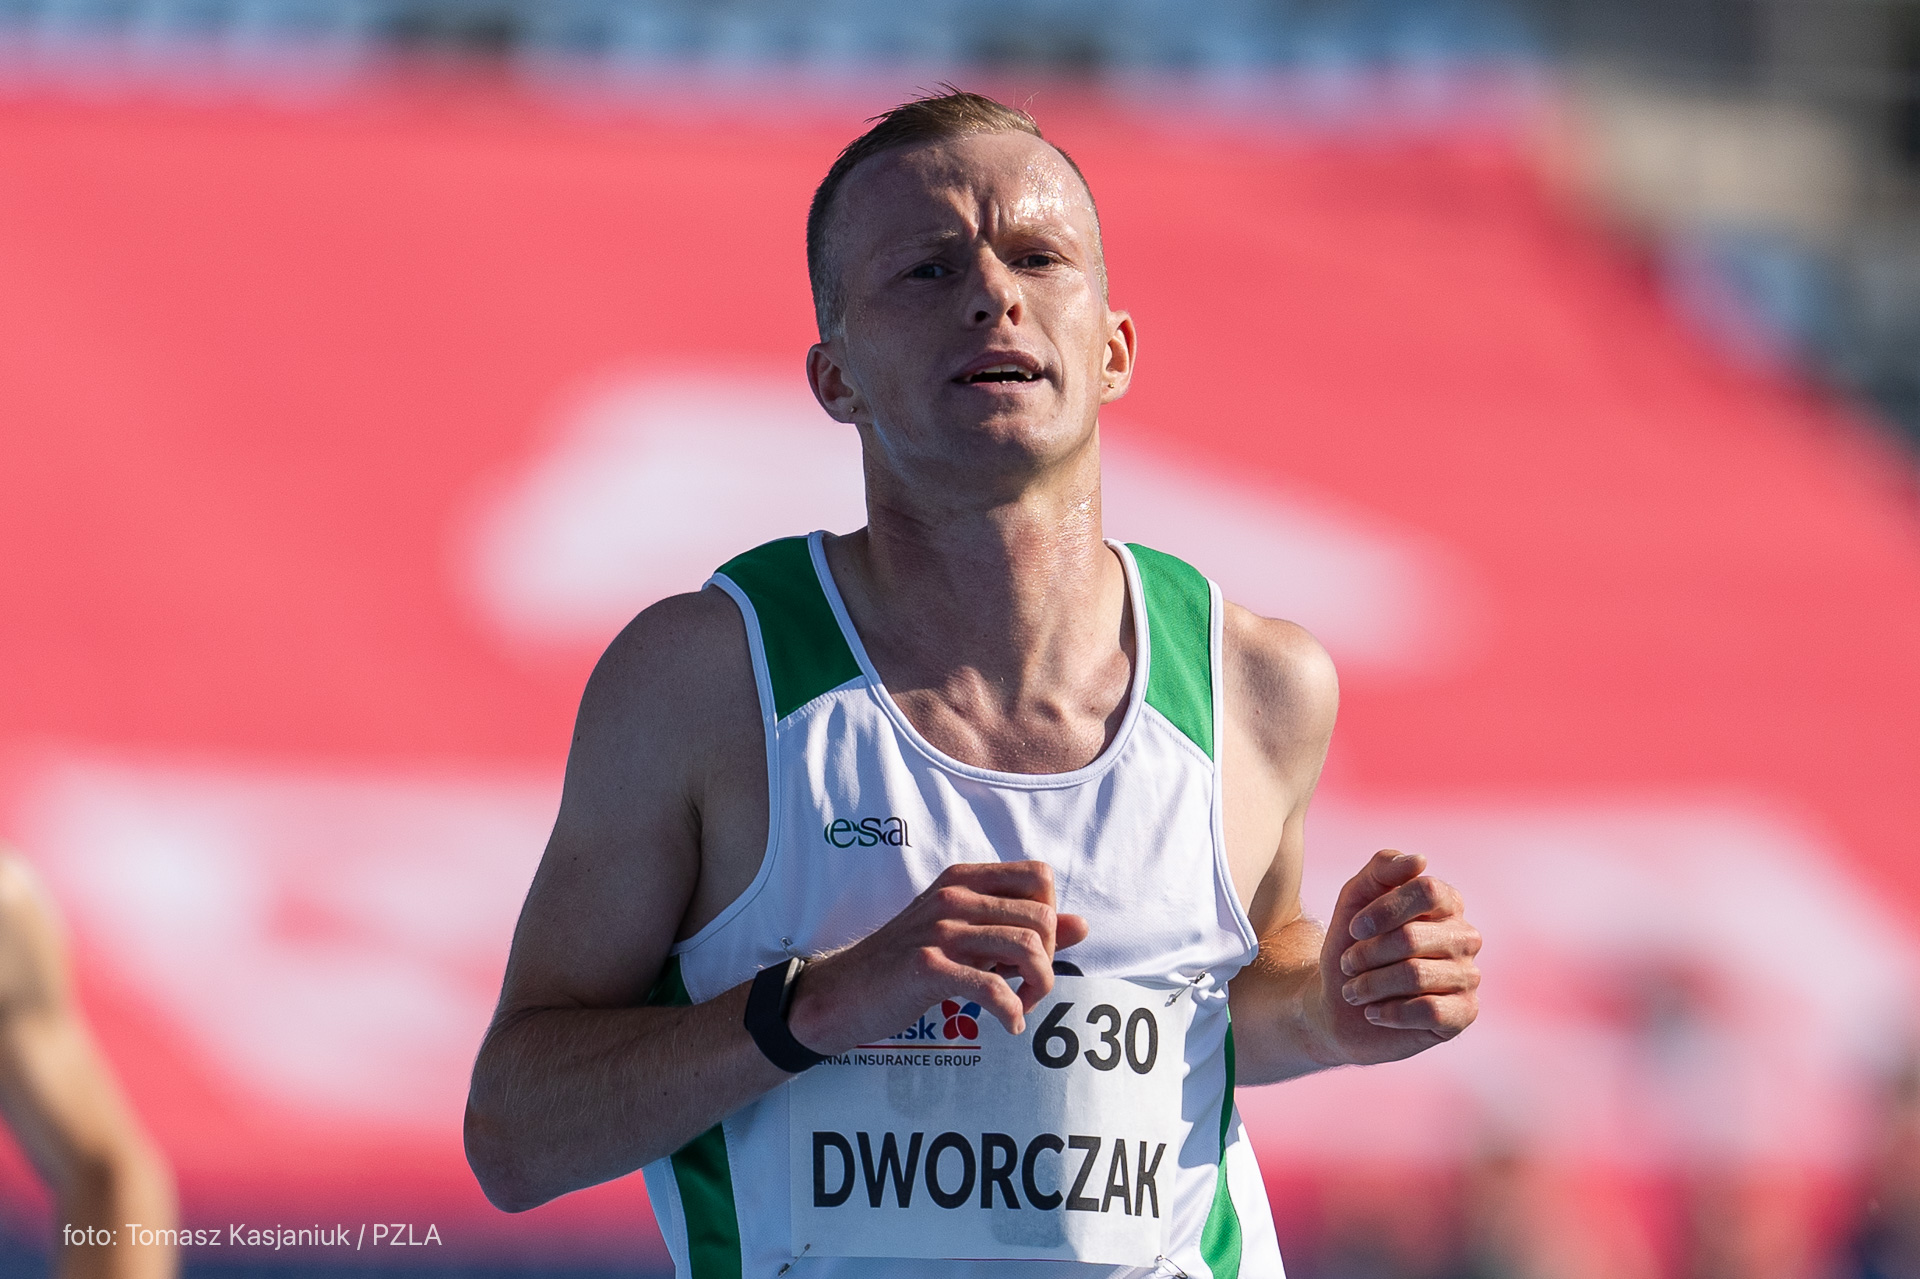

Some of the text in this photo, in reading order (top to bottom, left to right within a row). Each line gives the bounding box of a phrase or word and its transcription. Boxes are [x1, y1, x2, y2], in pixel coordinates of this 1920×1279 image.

[824, 816, 913, 848] esa
[854, 1054, 931, 1067] INSURANCE
[934, 1055, 982, 1067] GROUP
[1031, 1001, 1159, 1075] 630
[811, 1130, 1167, 1219] DWORCZAK
